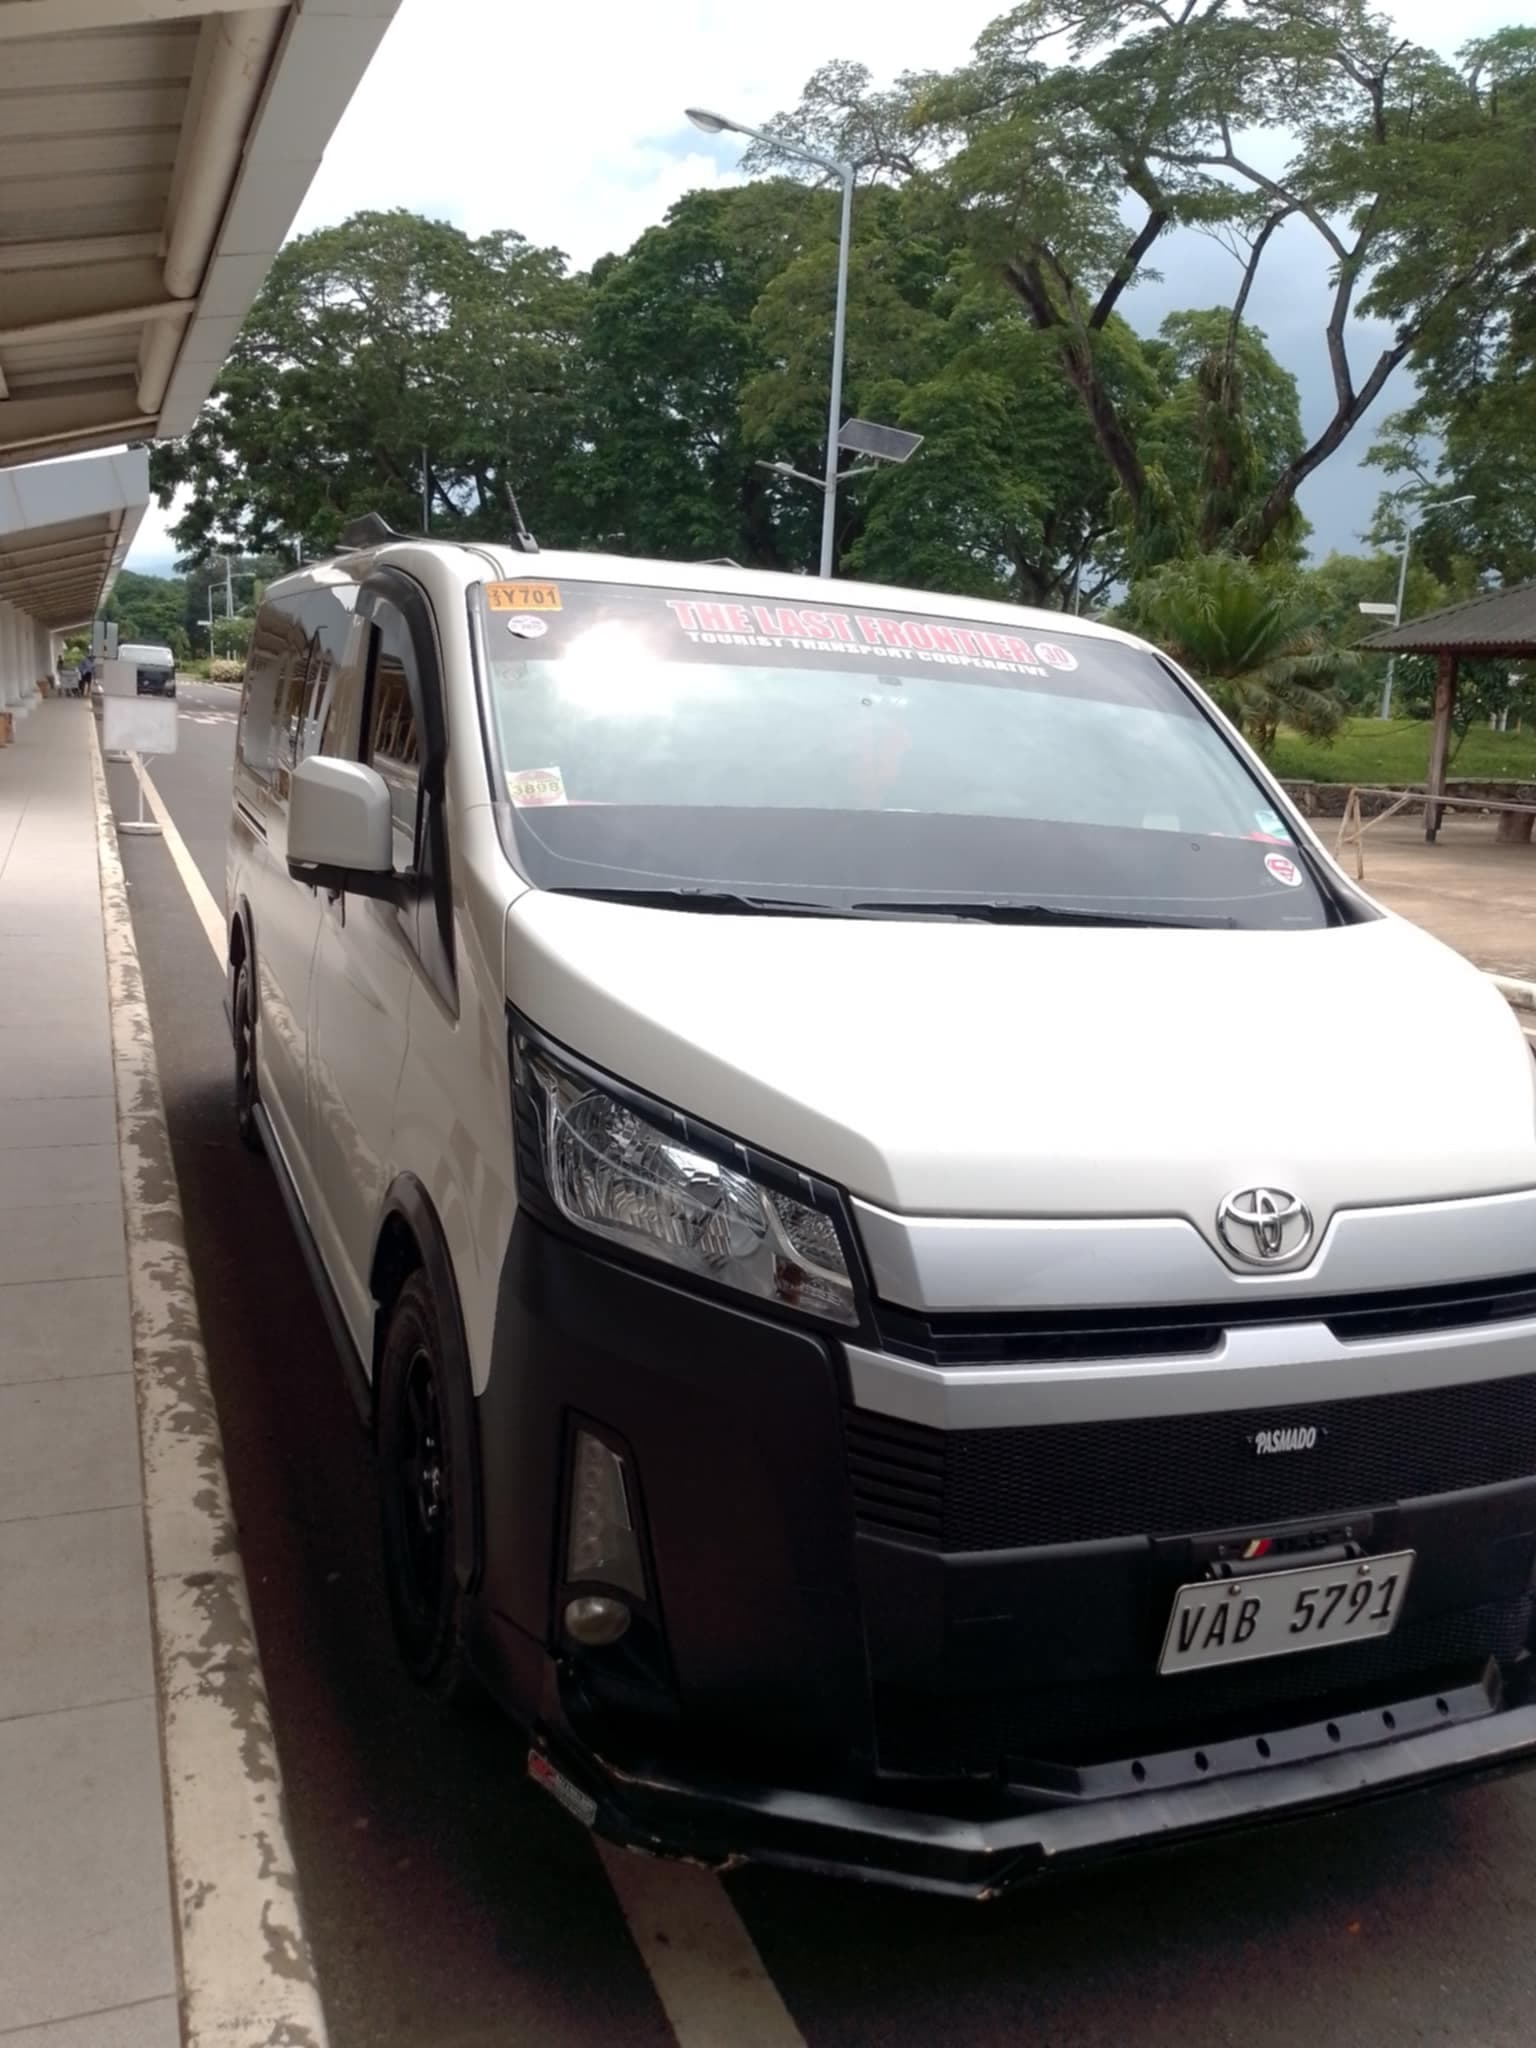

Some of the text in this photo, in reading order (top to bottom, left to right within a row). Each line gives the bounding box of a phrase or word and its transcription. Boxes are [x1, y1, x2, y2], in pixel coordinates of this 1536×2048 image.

[666, 599, 755, 634] THE
[752, 605, 856, 642] LAST
[855, 615, 1039, 665] FRONTIER
[685, 631, 1049, 678] TOURIST TRANSPORT COOPERATIVE
[1254, 1426, 1317, 1455] PASMADO
[1176, 1574, 1399, 1654] VAB 5791
